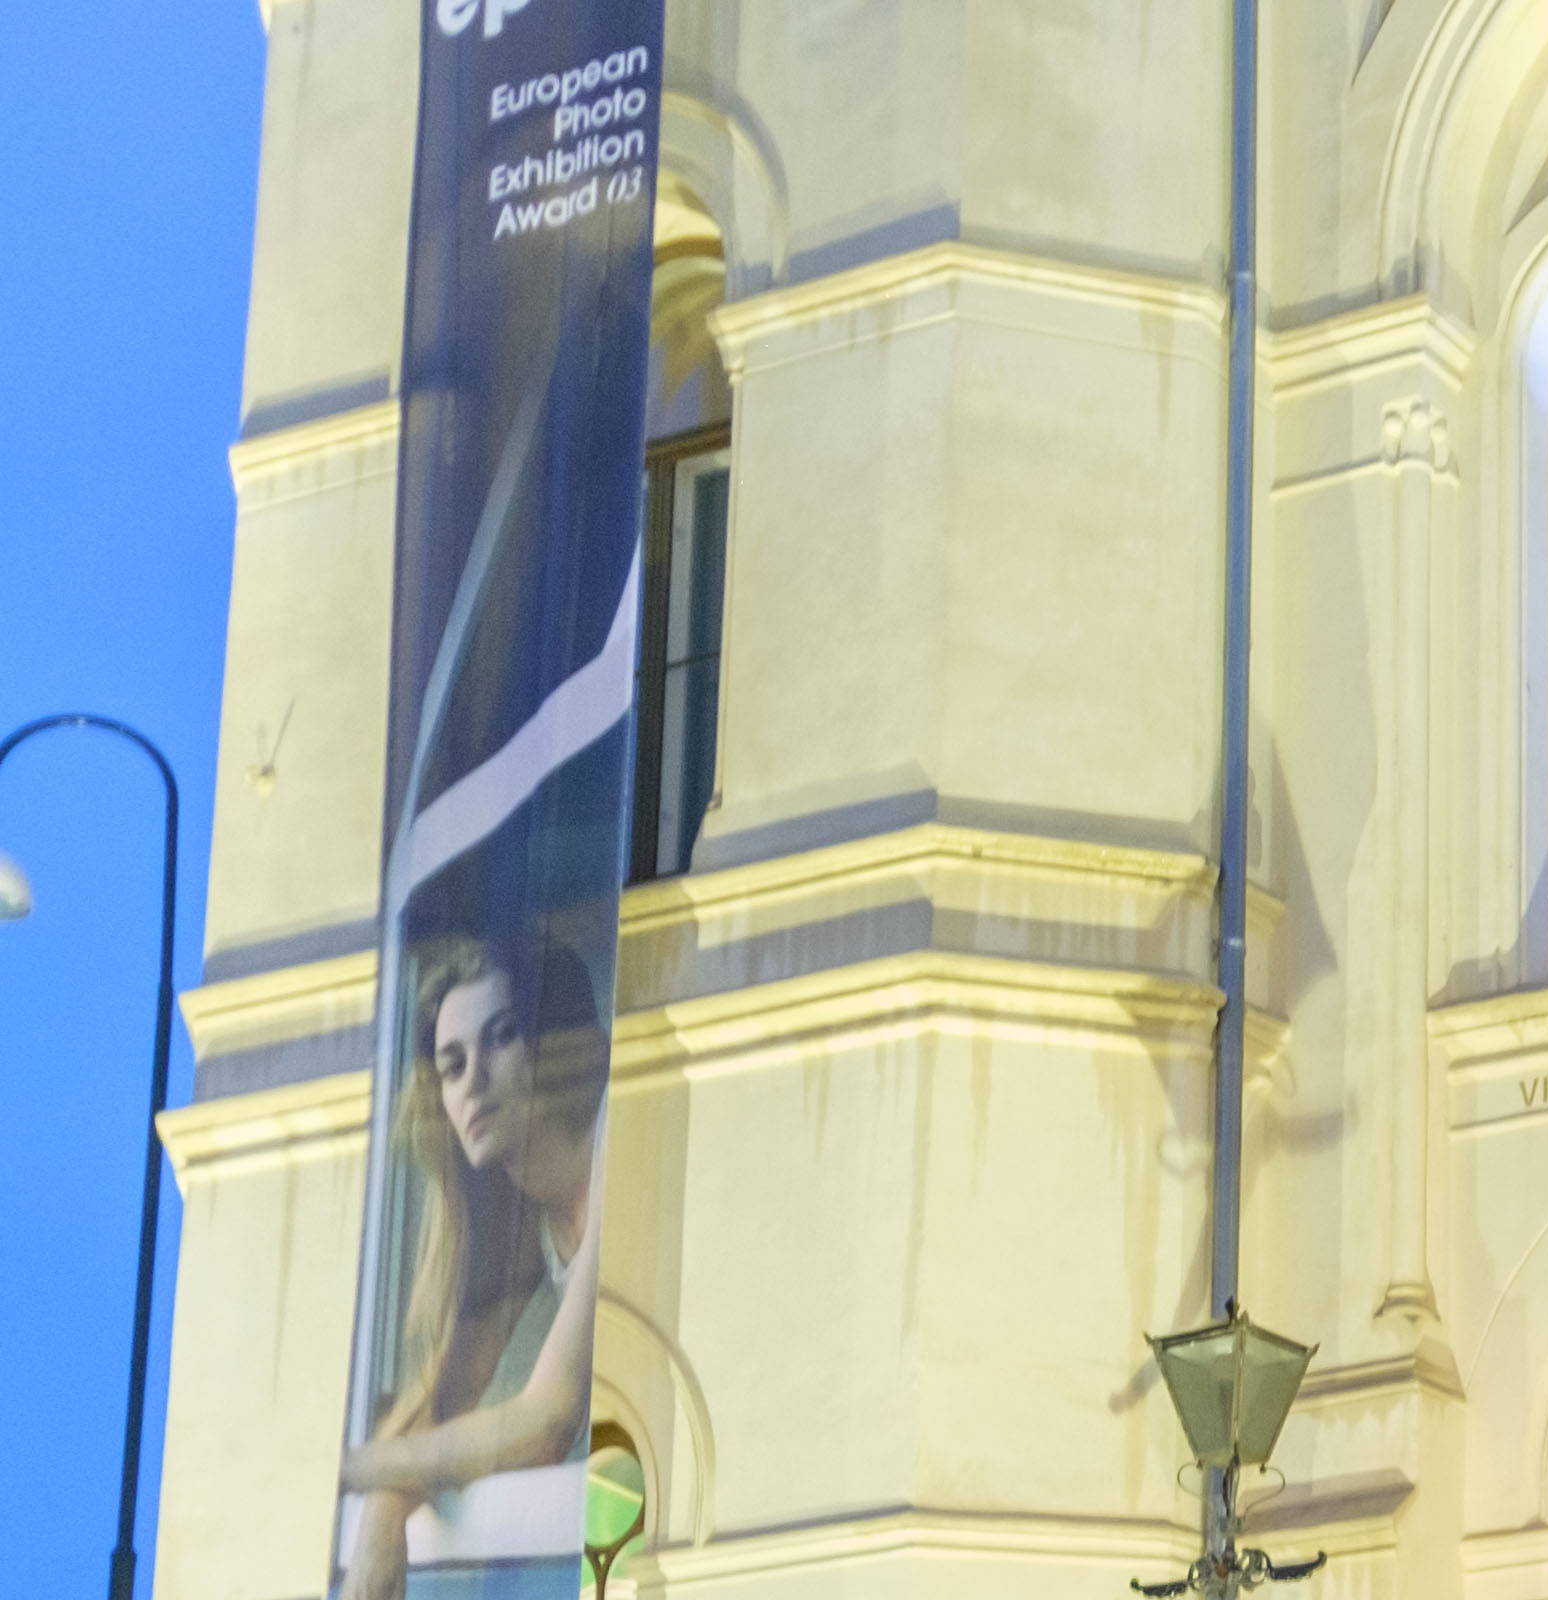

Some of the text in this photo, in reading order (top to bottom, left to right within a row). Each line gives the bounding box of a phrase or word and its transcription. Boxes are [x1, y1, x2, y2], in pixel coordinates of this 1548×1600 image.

[489, 45, 648, 121] European
[488, 129, 645, 201] Exhibition
[493, 165, 644, 240] Award 03
